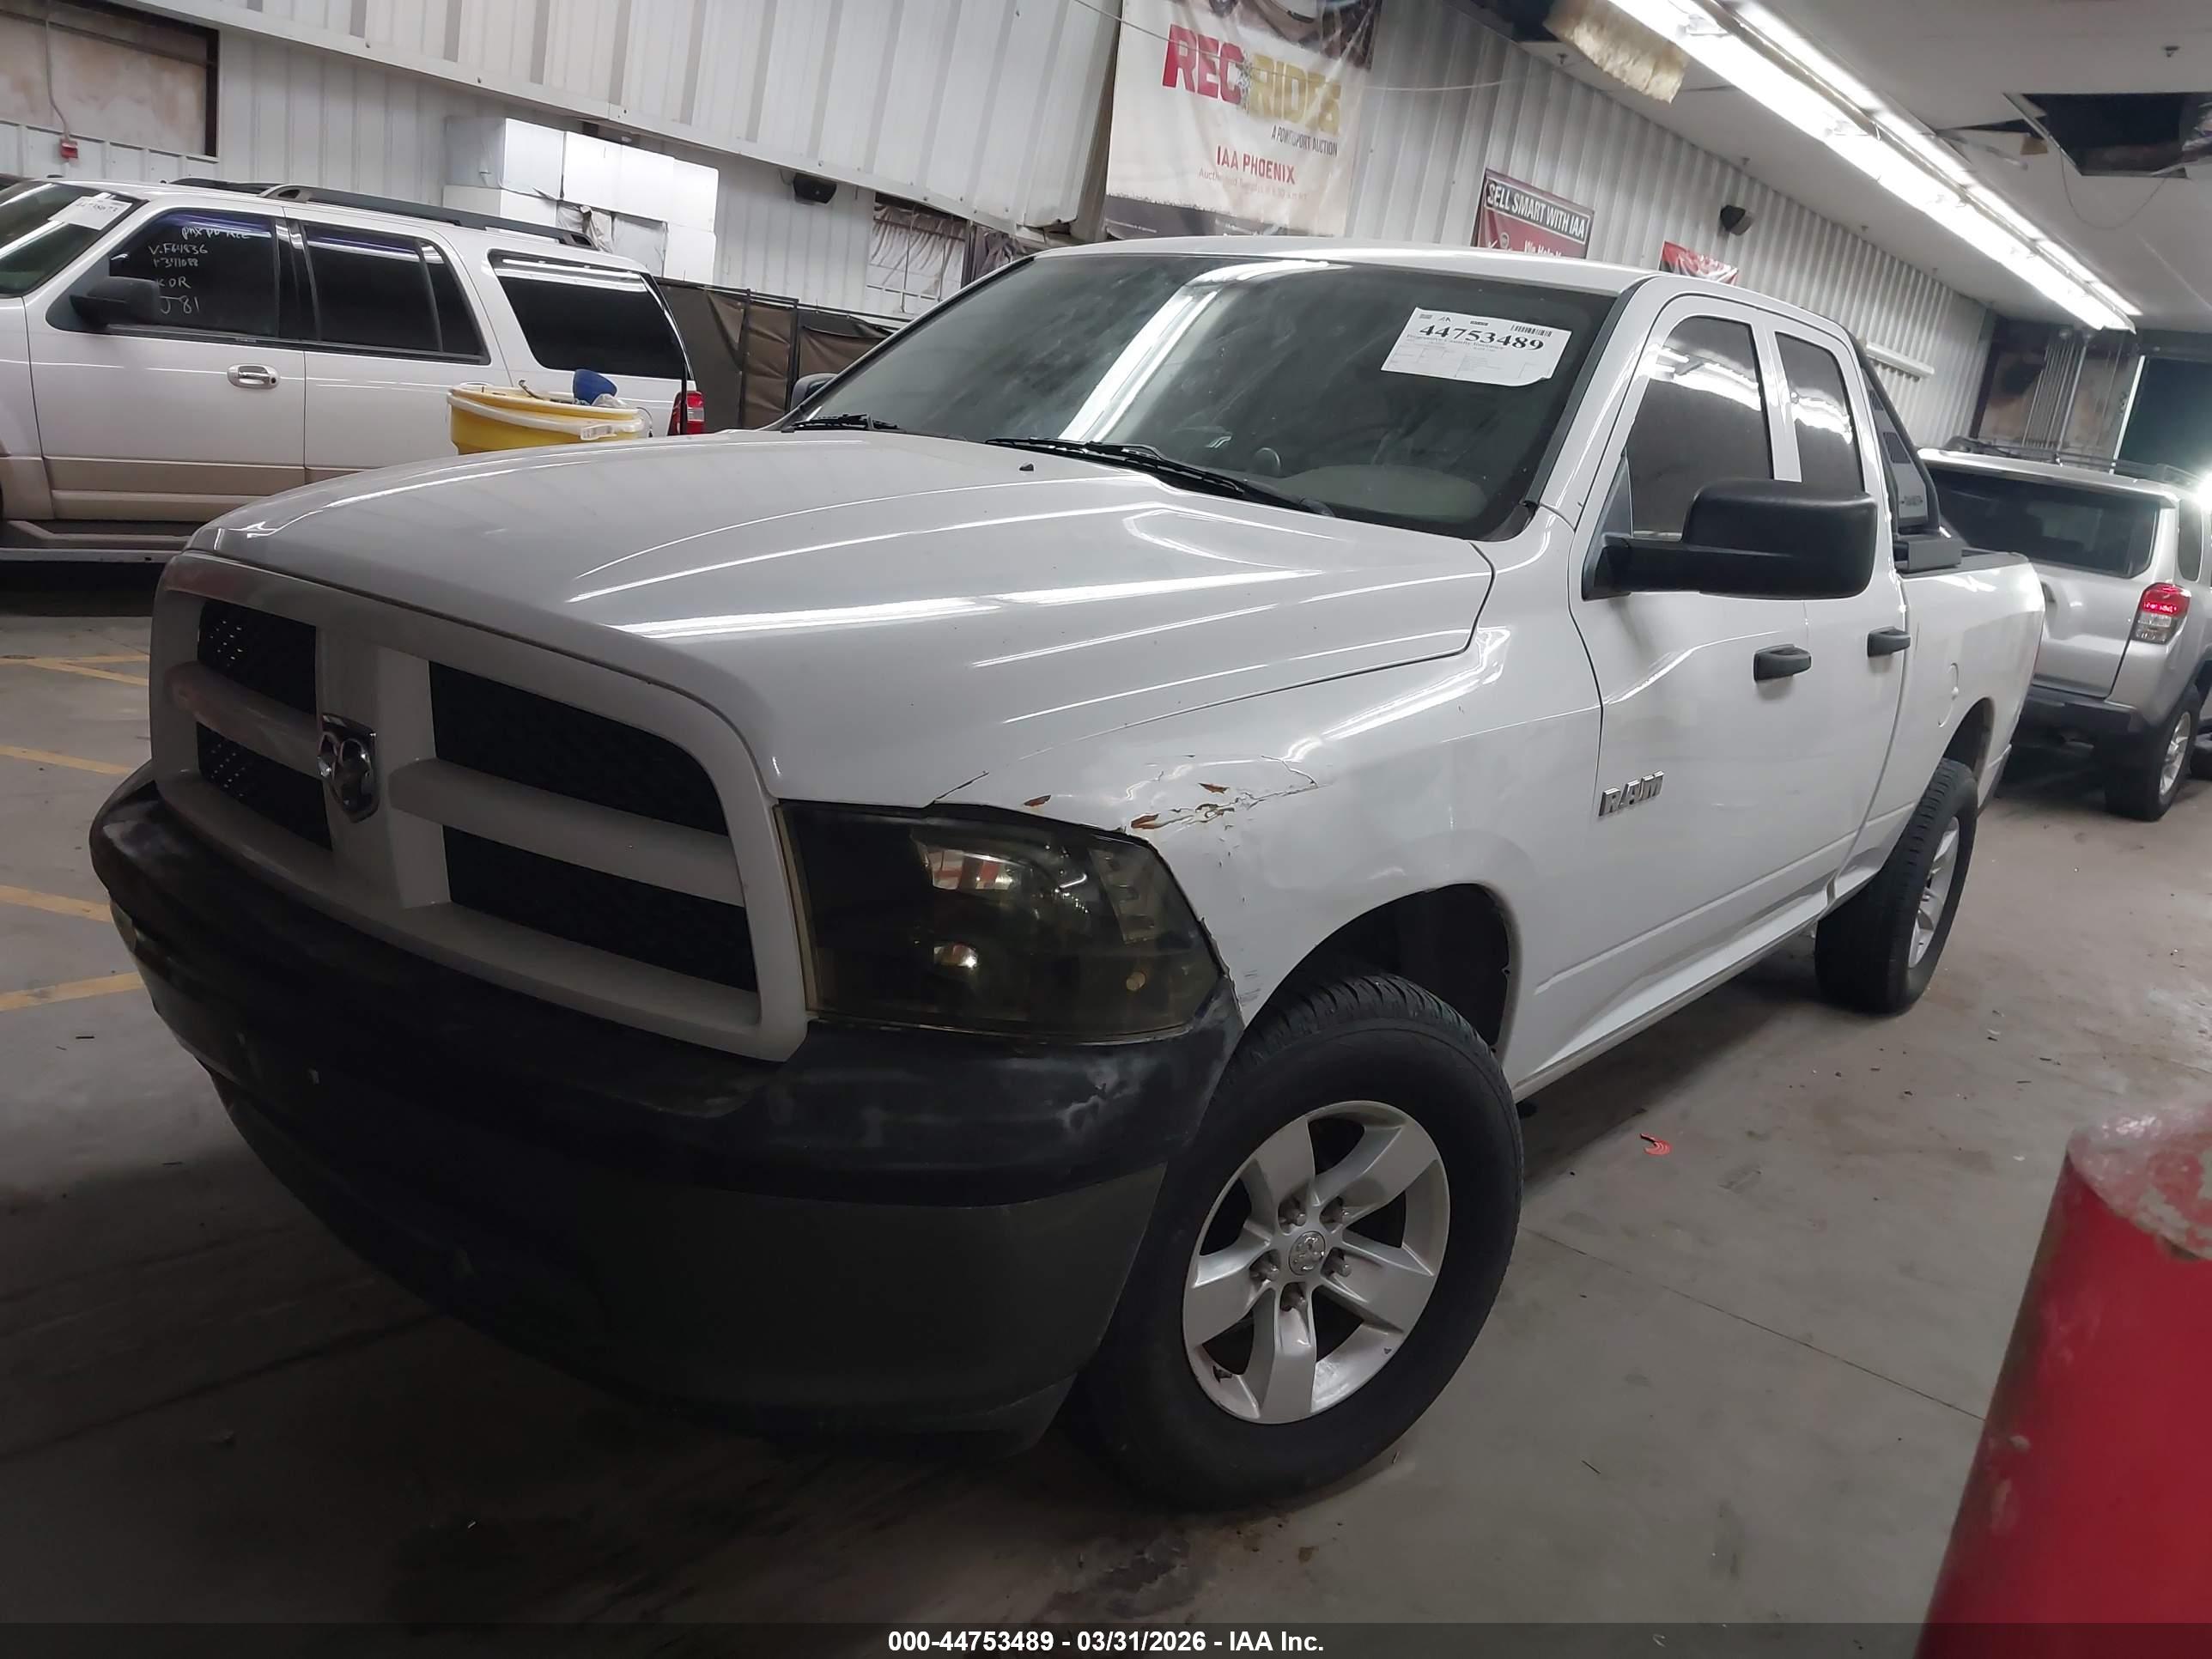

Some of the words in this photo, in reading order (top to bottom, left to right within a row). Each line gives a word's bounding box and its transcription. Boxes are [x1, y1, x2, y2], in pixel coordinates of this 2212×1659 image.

[1217, 145, 1238, 170] IAA
[1243, 153, 1295, 185] PHOENIX
[1312, 137, 1338, 158] AUCTION
[1487, 184, 1511, 210] SELL
[1512, 193, 1546, 223] SMART
[1547, 206, 1569, 233] WITH
[1569, 216, 1585, 240] IAA
[1419, 325, 1544, 350] 44753489
[1598, 770, 1664, 817] RAM
